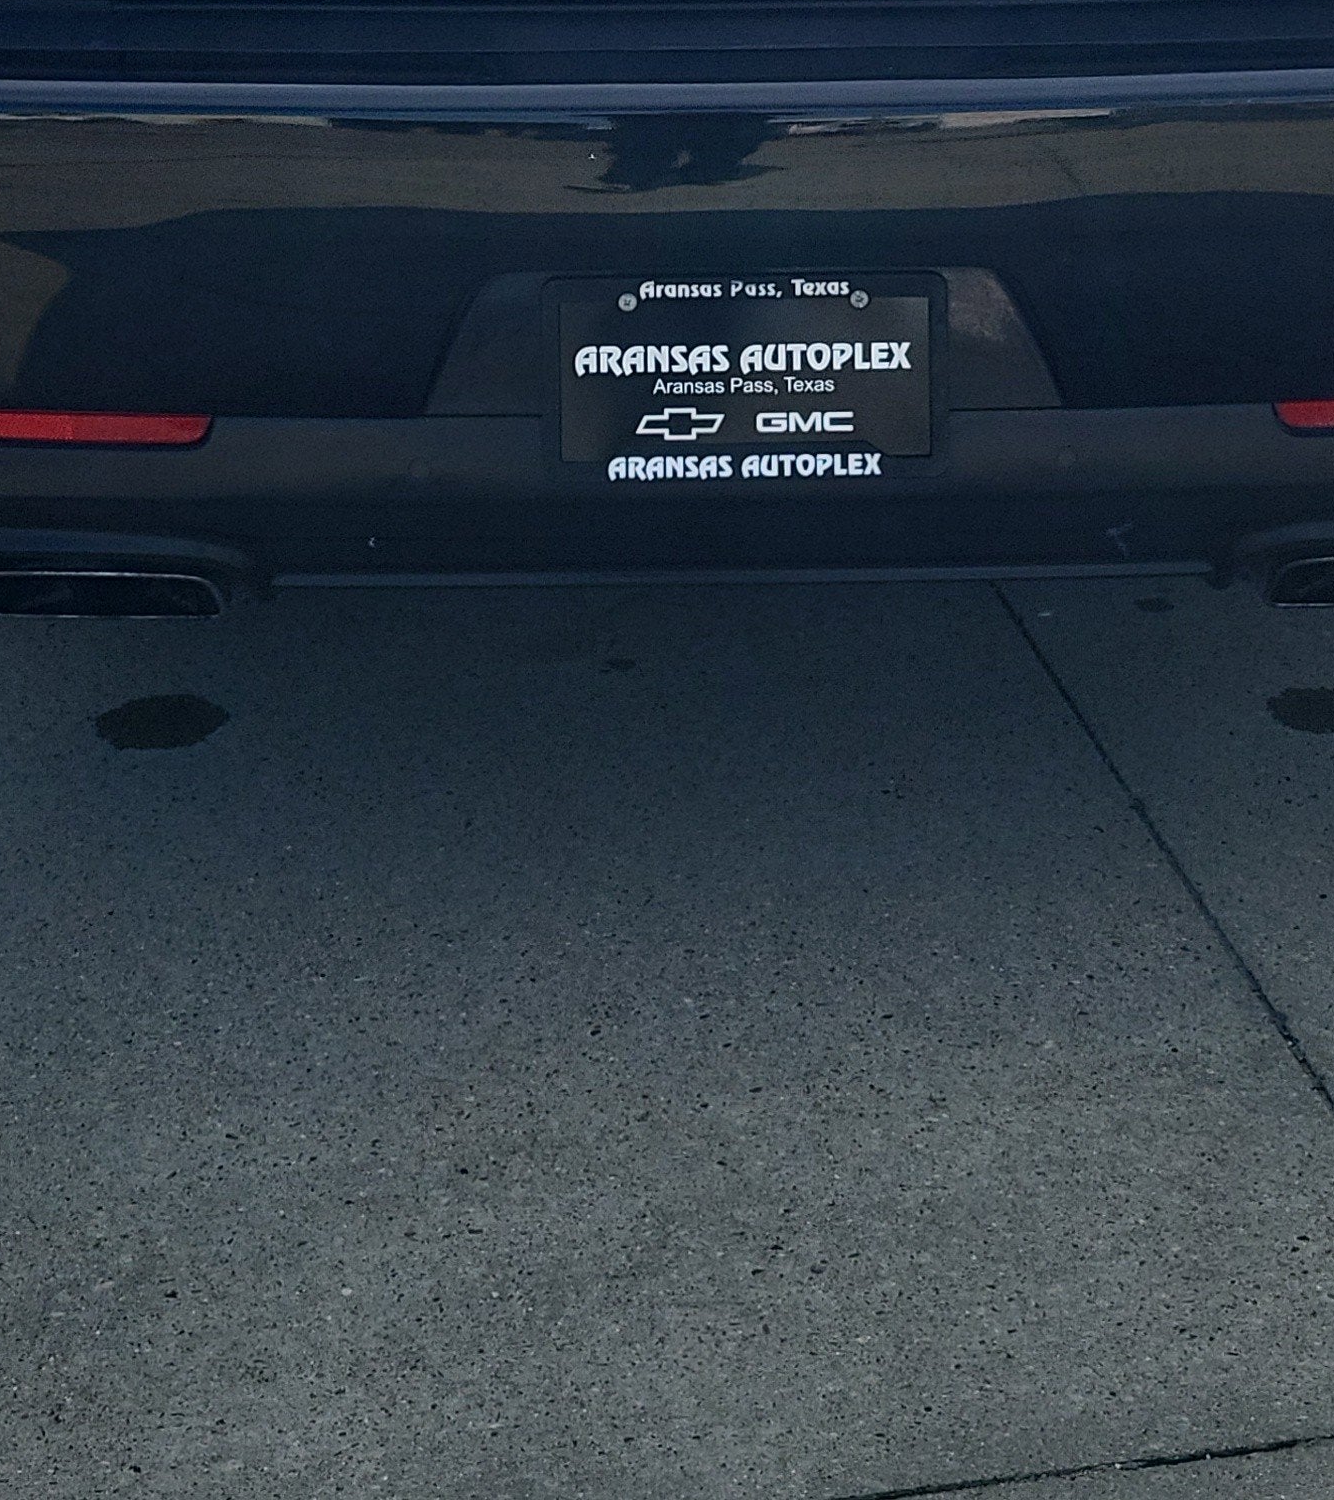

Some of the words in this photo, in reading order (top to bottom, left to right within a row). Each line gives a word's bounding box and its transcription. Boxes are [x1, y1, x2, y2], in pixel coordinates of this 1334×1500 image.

[639, 280, 723, 300] Aransas
[729, 280, 783, 298] Pass,
[790, 278, 851, 296] Texas
[574, 344, 730, 377] ARANSAS
[739, 341, 912, 375] AUTOPLEX
[652, 378, 725, 395] Aransas
[729, 377, 779, 395] Pass,
[783, 376, 835, 393] Texas
[755, 410, 855, 433] GMC
[607, 454, 734, 481] ARANSAS
[741, 452, 882, 477] AUTOPLEX
